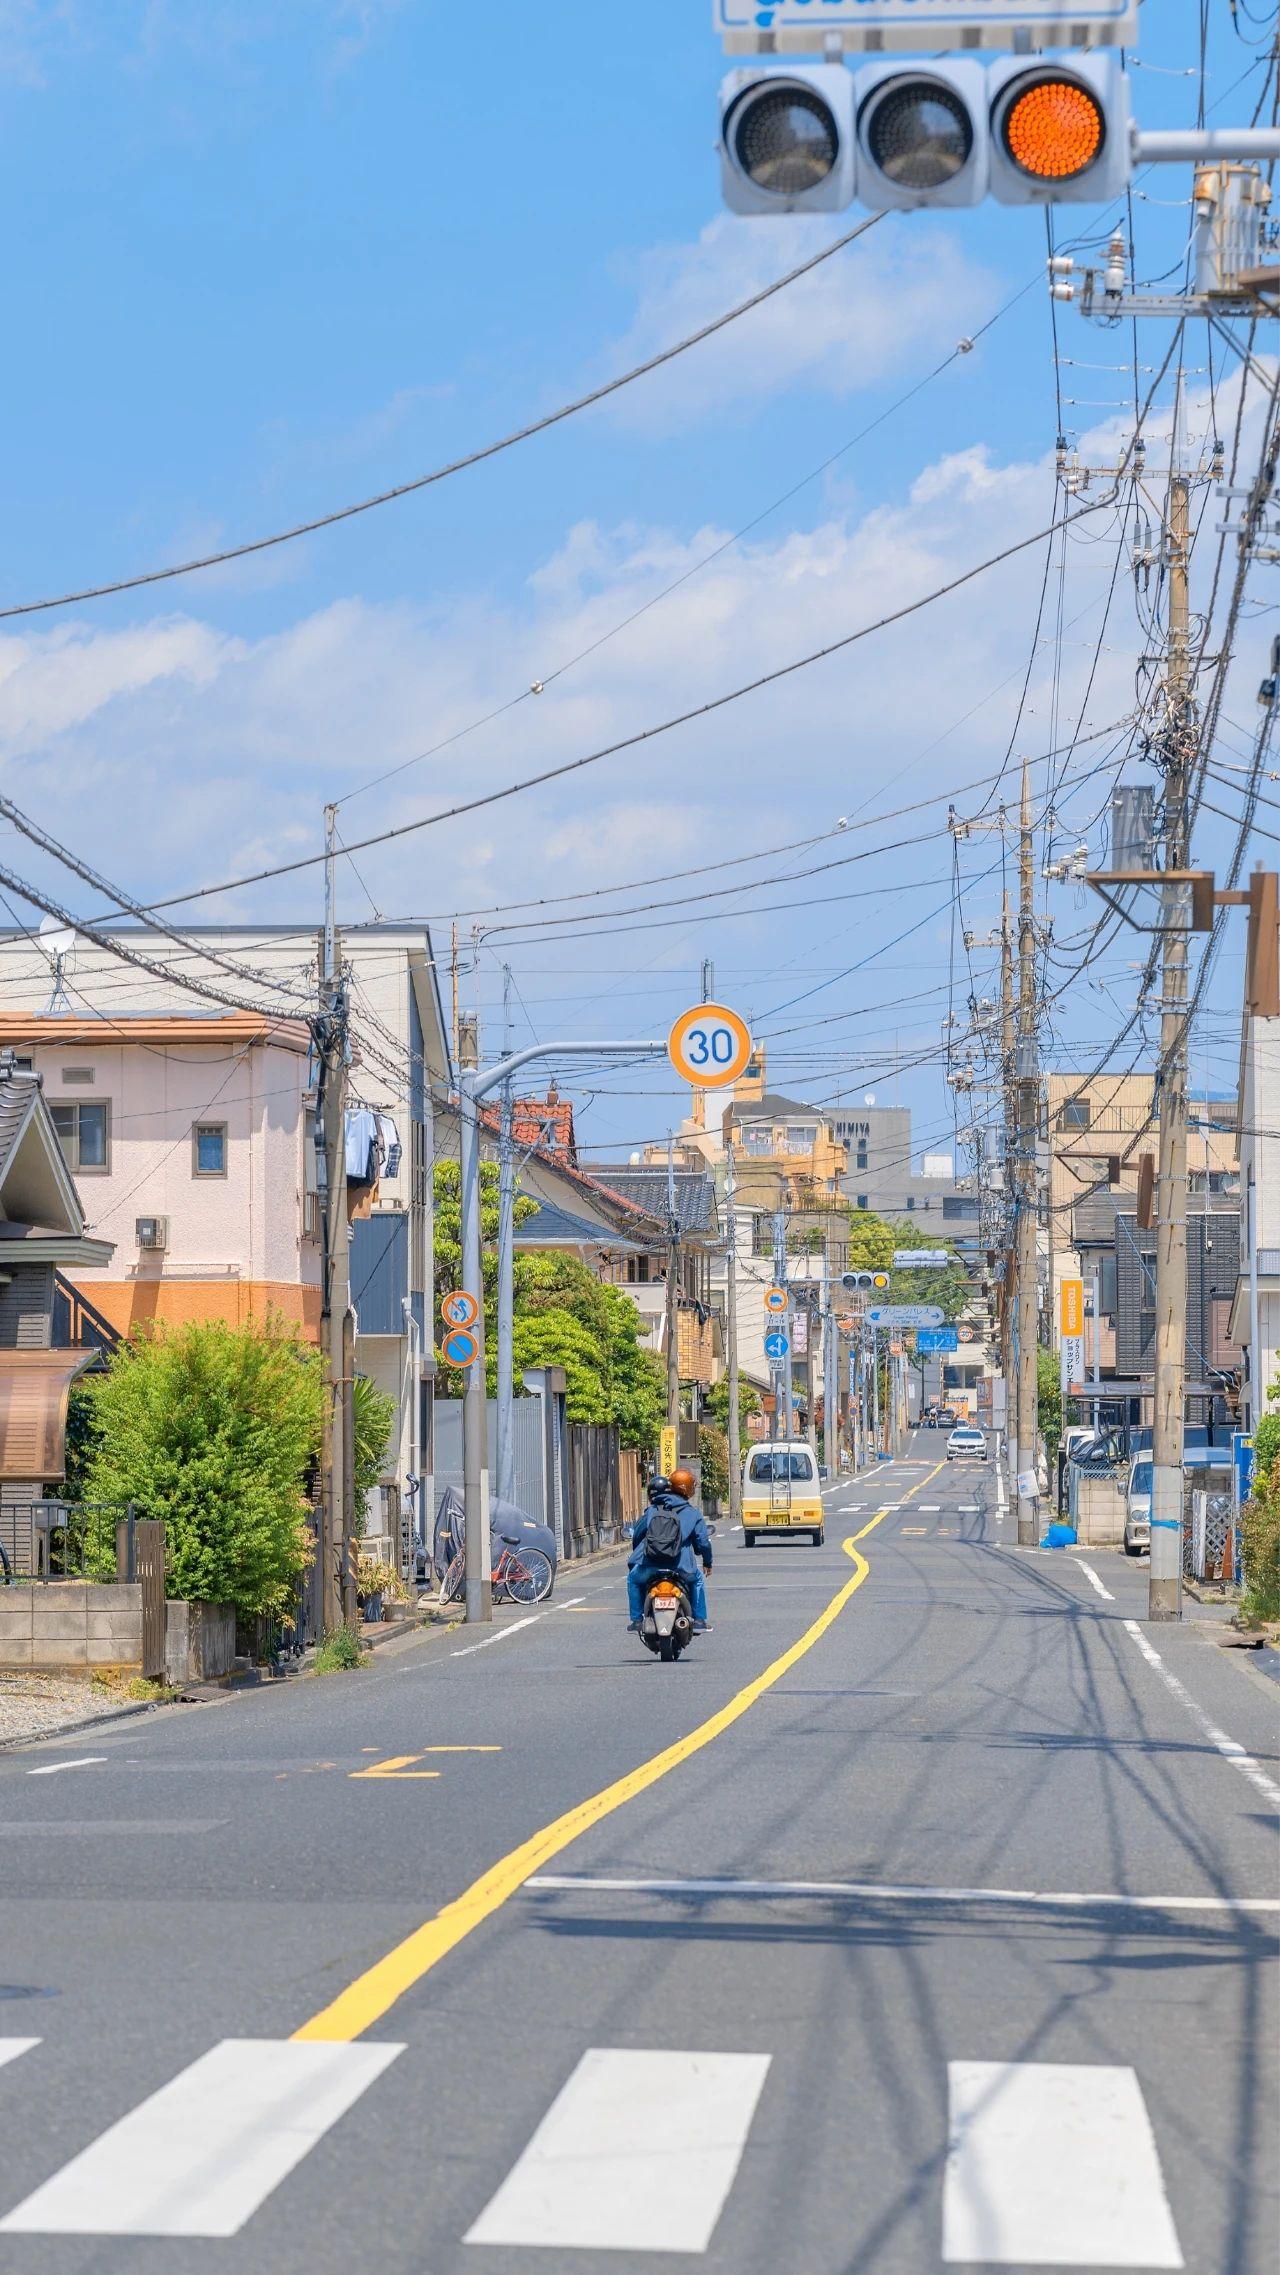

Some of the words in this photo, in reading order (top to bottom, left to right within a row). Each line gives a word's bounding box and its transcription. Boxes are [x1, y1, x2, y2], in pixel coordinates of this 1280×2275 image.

[688, 1029, 732, 1064] 30
[882, 1307, 930, 1315] グリーンパレス
[1067, 1286, 1076, 1330] TOSHIBA
